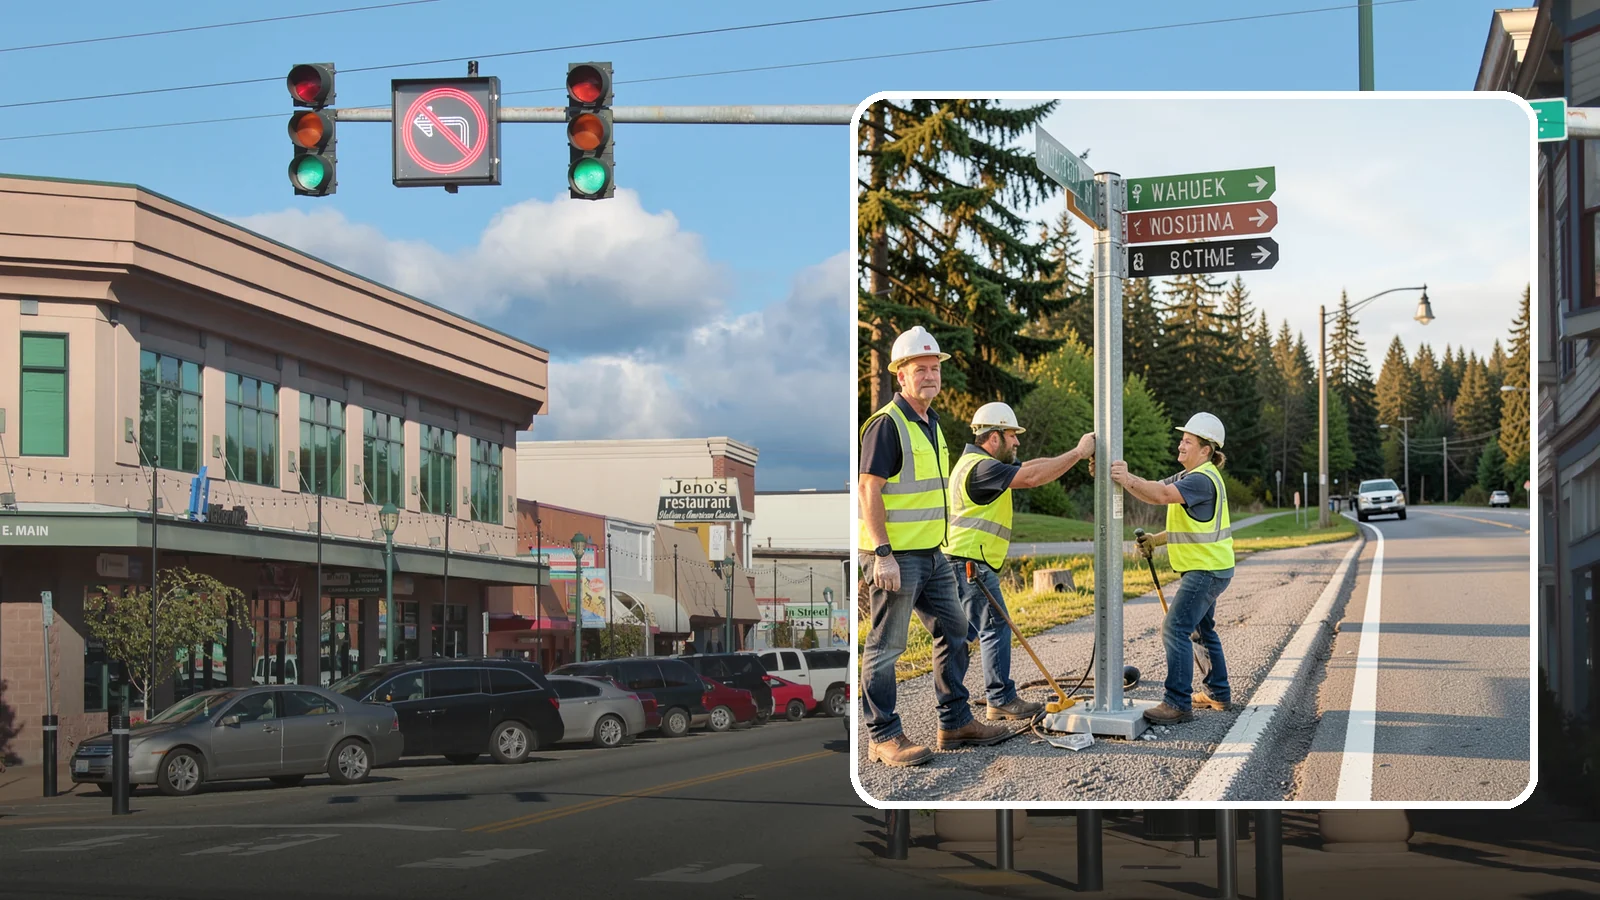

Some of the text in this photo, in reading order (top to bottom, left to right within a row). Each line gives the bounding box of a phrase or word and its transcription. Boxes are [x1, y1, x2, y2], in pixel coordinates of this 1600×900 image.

[670, 480, 727, 494] Jeno's
[665, 496, 731, 509] restaurant
[685, 509, 714, 519] American
[715, 509, 737, 519] Cuisine
[2, 525, 49, 536] E. MAIN
[797, 607, 828, 616] Street
[790, 619, 824, 627] lass
